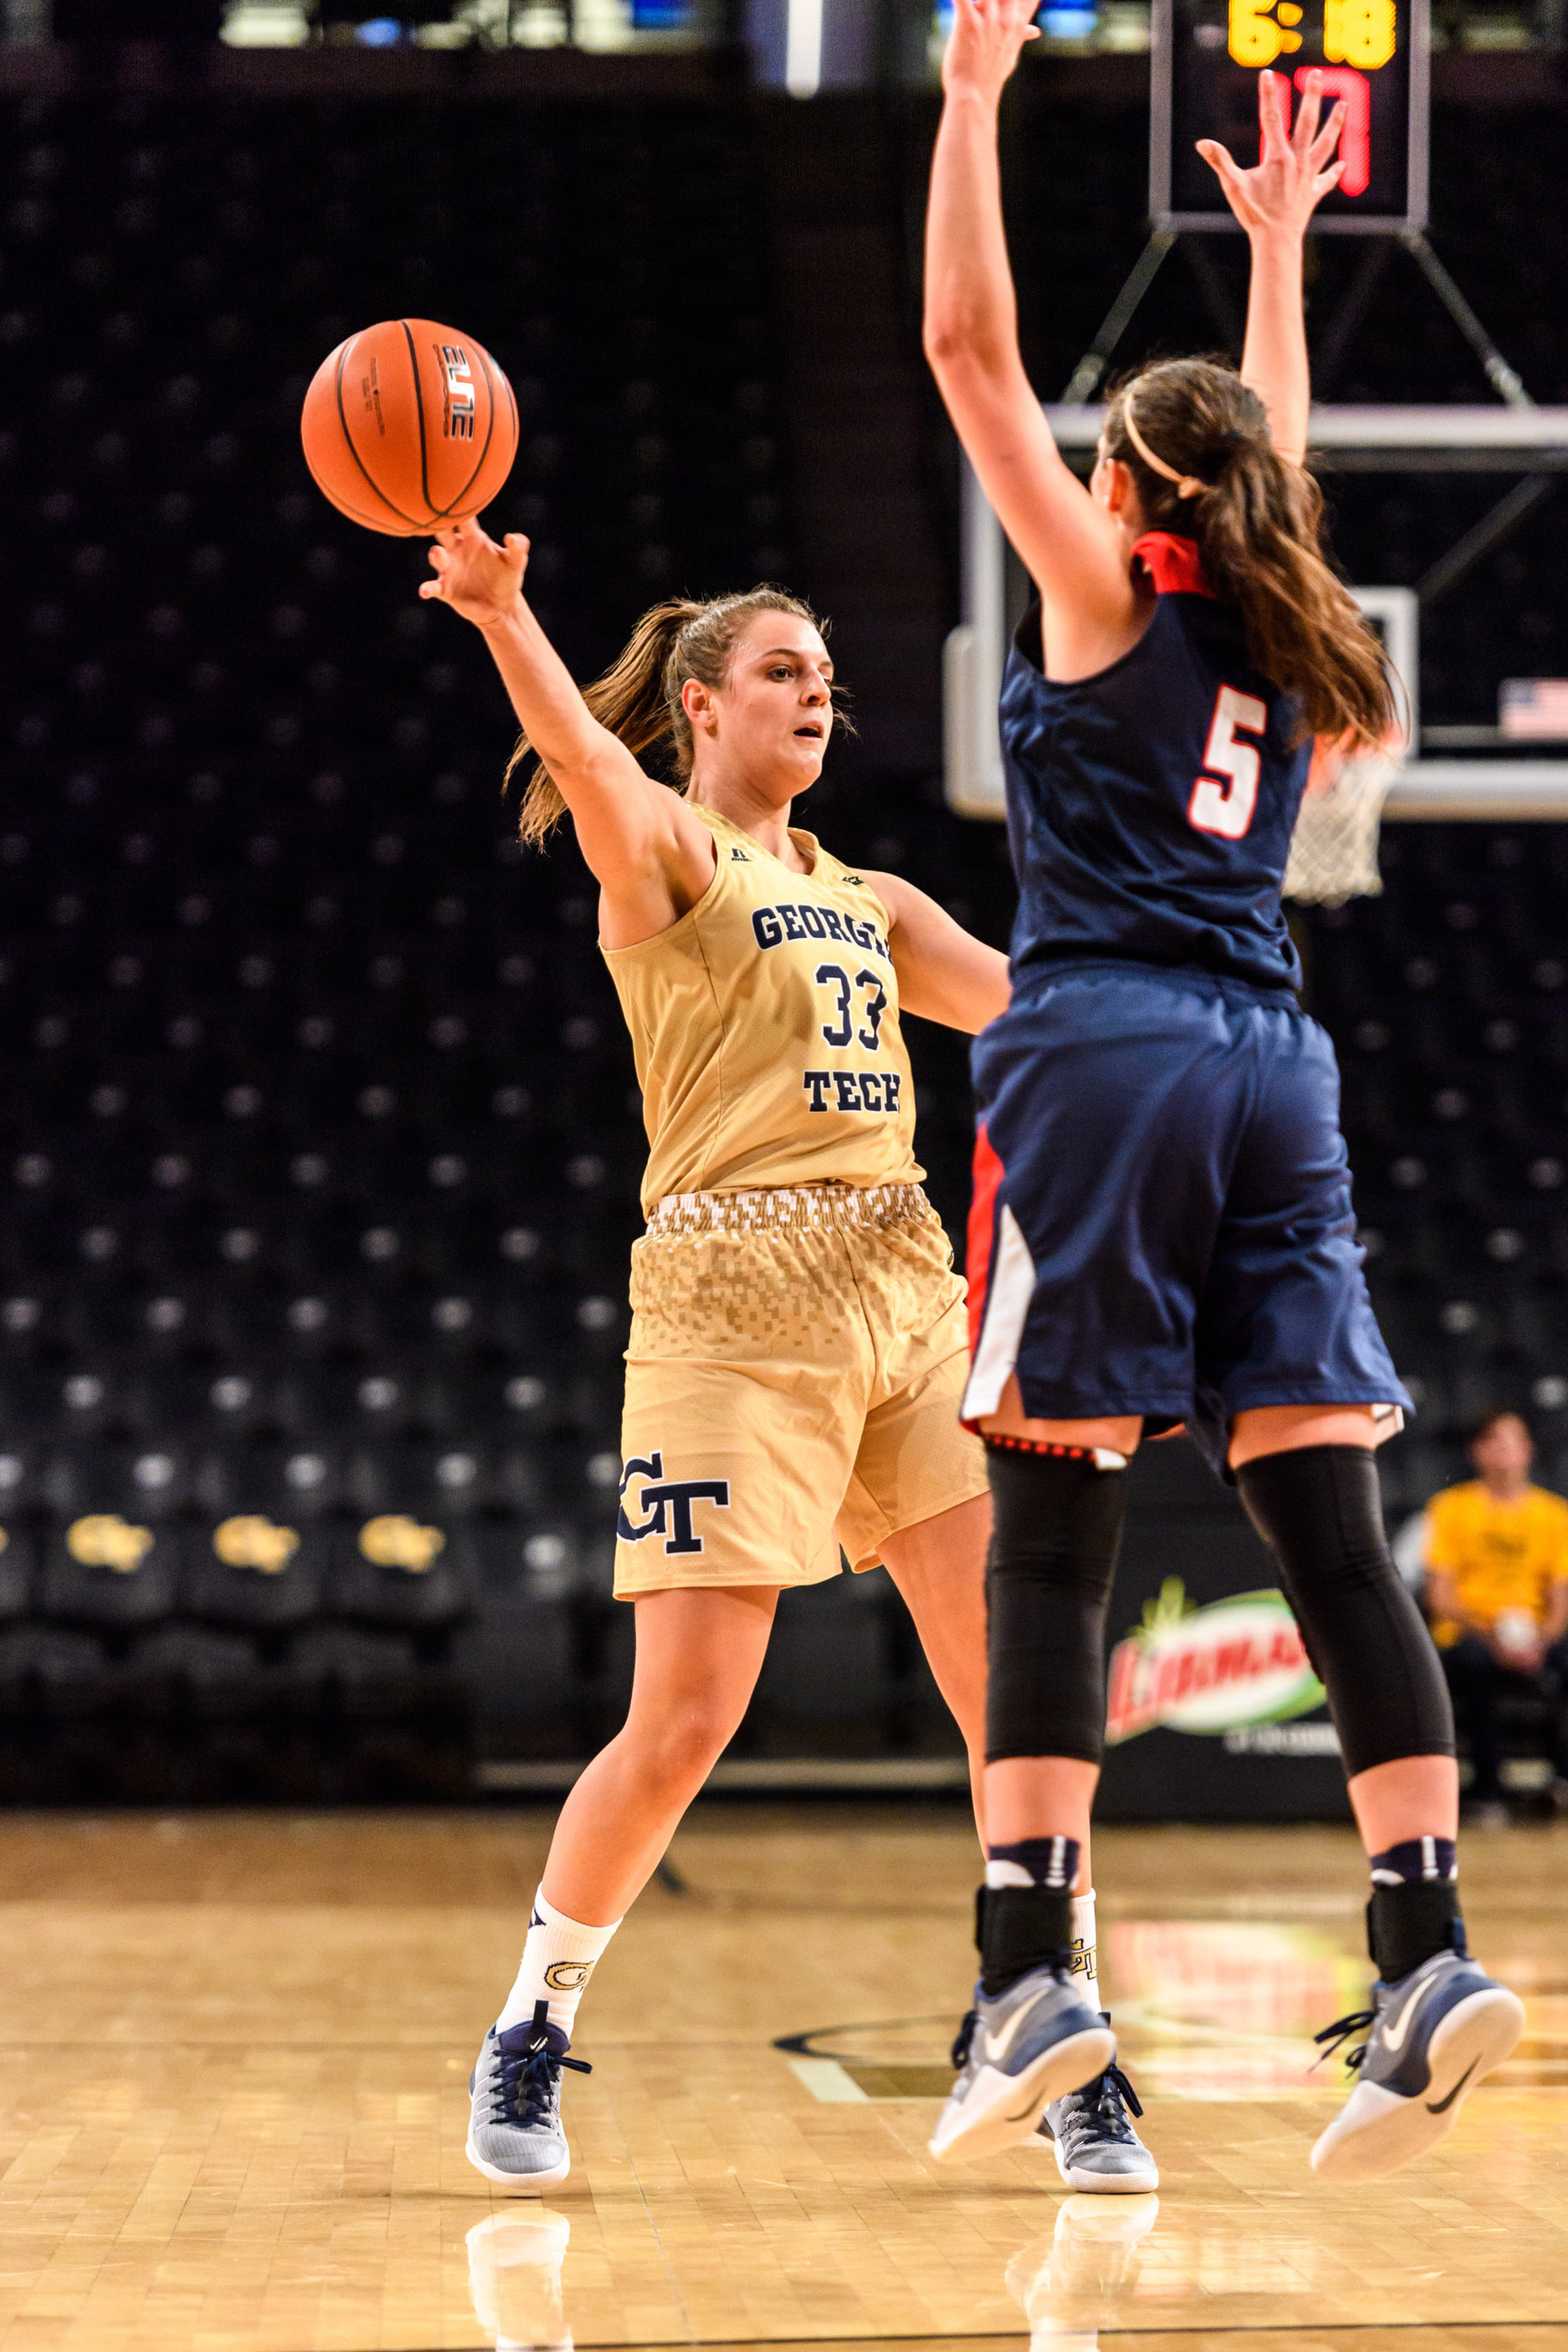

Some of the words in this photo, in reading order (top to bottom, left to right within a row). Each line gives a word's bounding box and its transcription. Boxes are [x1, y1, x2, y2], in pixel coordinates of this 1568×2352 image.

[440, 344, 475, 442] ELITE
[1187, 683, 1268, 840] 5
[814, 962, 888, 1051] 33
[802, 1071, 901, 1114] TECH
[616, 1449, 731, 1557] GT
